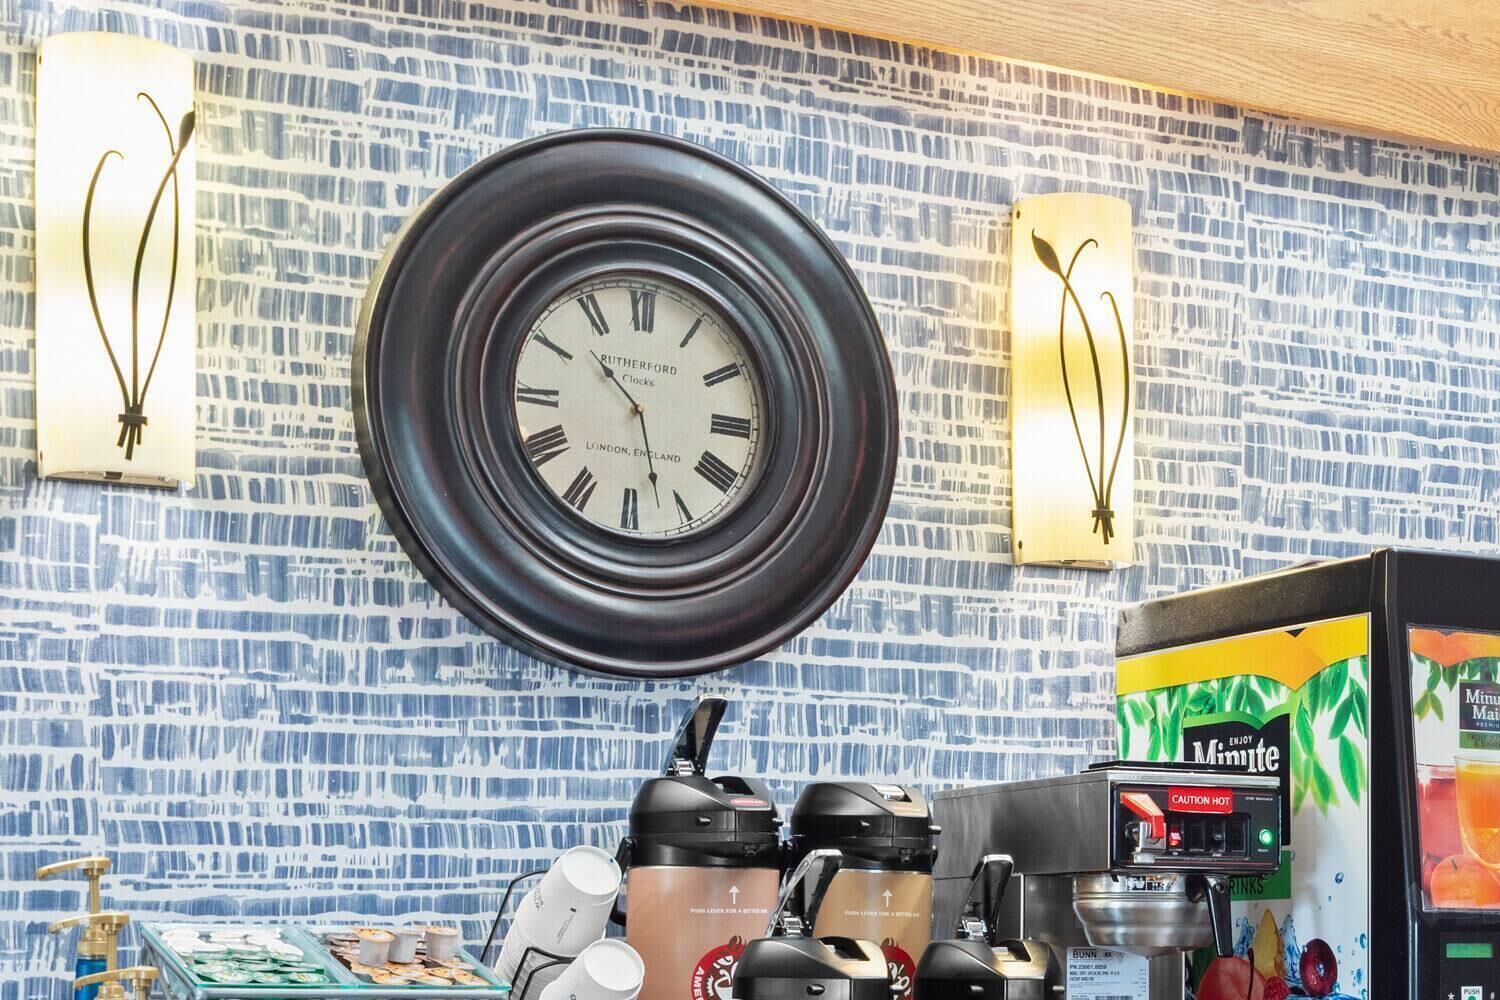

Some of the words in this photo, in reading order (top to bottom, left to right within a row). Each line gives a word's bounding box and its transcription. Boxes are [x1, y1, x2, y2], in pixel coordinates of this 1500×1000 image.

[600, 354, 678, 376] RUTHERFORD
[622, 373, 655, 387] Clocks
[633, 448, 681, 463] ENGLAND
[1229, 735, 1253, 746] ENJOY
[1192, 737, 1280, 772] Minute
[1172, 795, 1210, 805] CAUTION
[1212, 797, 1230, 806] HOT
[1228, 879, 1264, 895] RINKS
